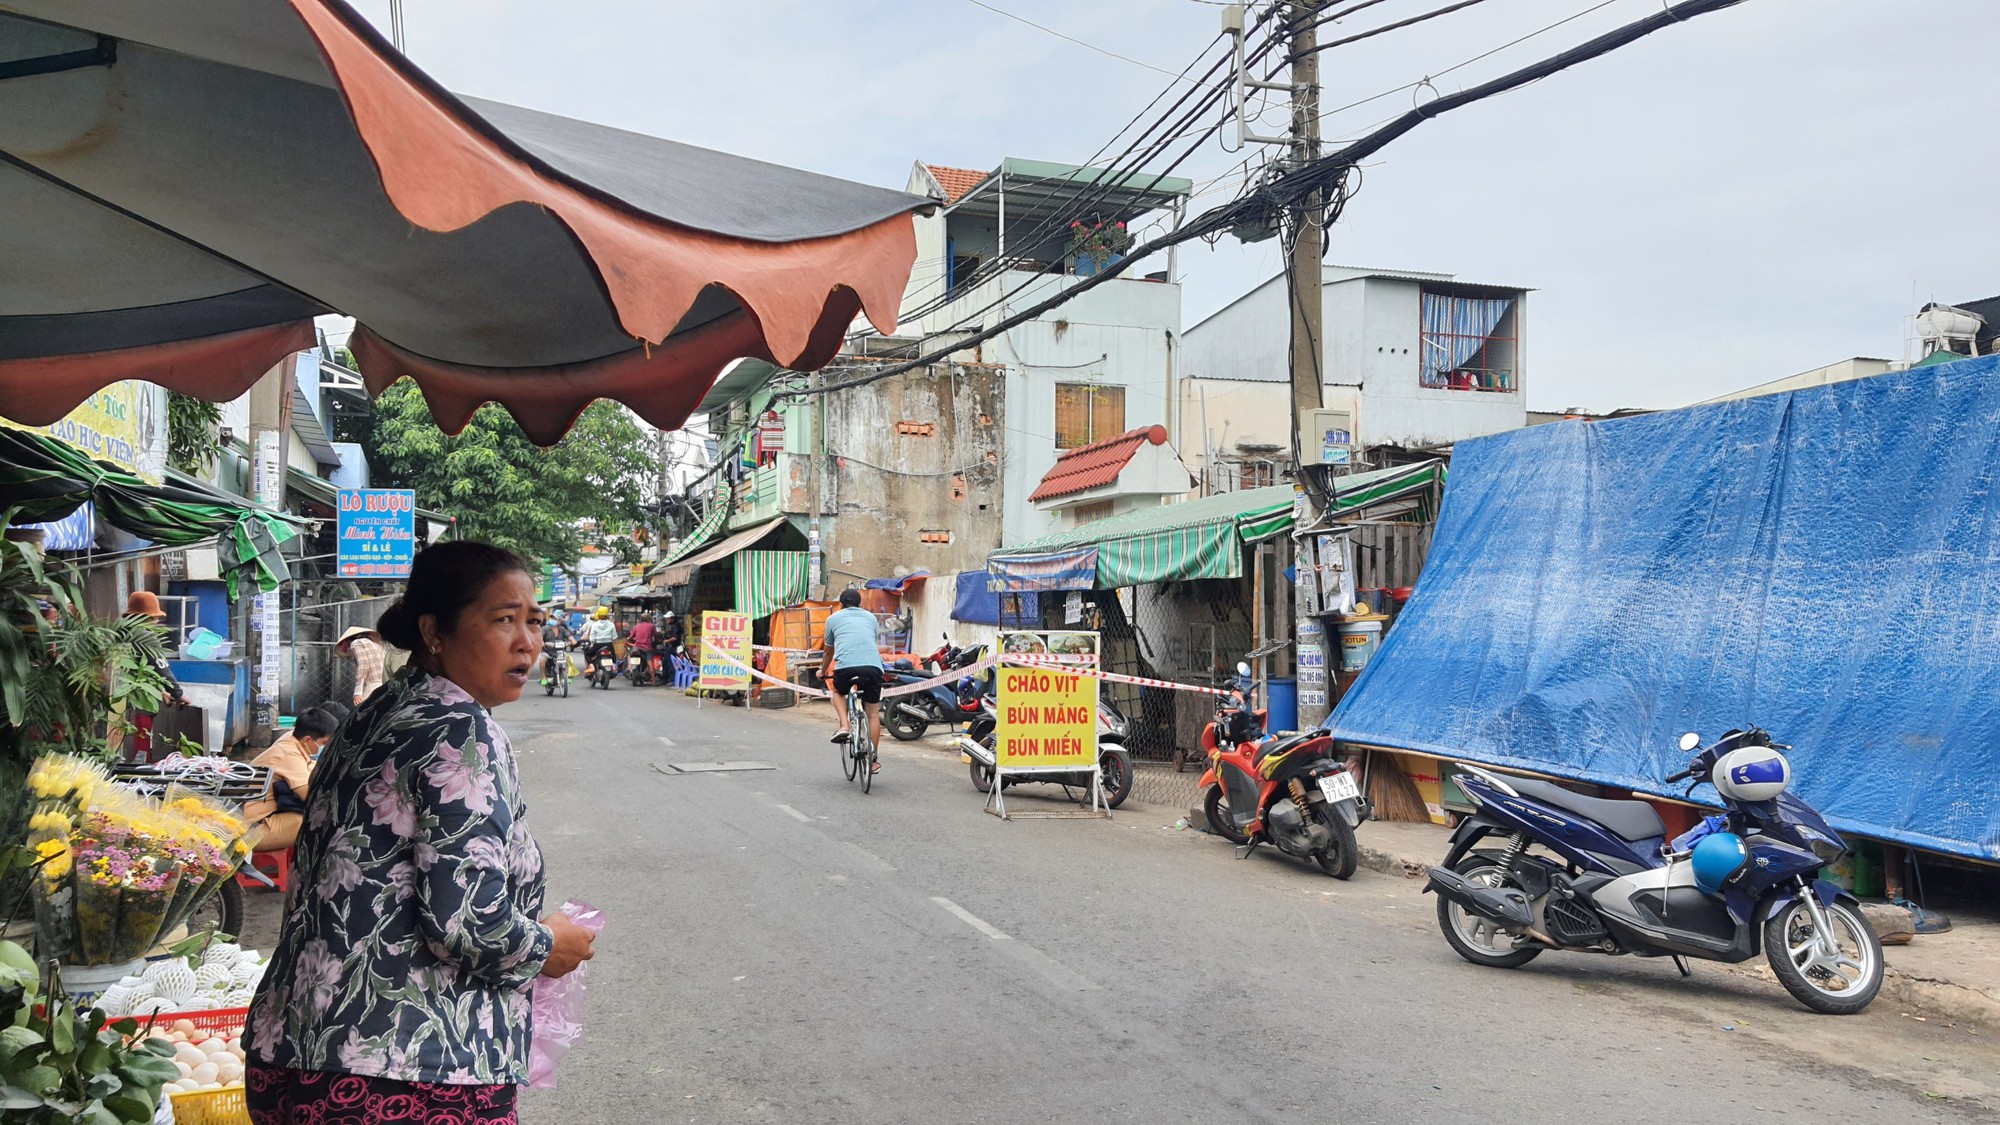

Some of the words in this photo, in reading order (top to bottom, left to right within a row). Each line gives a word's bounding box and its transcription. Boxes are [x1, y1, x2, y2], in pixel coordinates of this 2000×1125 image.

[103, 393, 126, 421] TÓC
[105, 436, 134, 464] VIÊN
[341, 490, 362, 511] LÒ
[365, 492, 412, 516] RƯỢU
[705, 615, 748, 632] GIỮ
[712, 635, 740, 650] XE
[1007, 670, 1050, 693] CHÁO
[1055, 675, 1080, 698] VỊT
[1007, 702, 1039, 724] BÚN
[1044, 702, 1088, 724] MĂNG
[1007, 734, 1039, 756] BÚN
[1044, 730, 1082, 756] MIẾN
